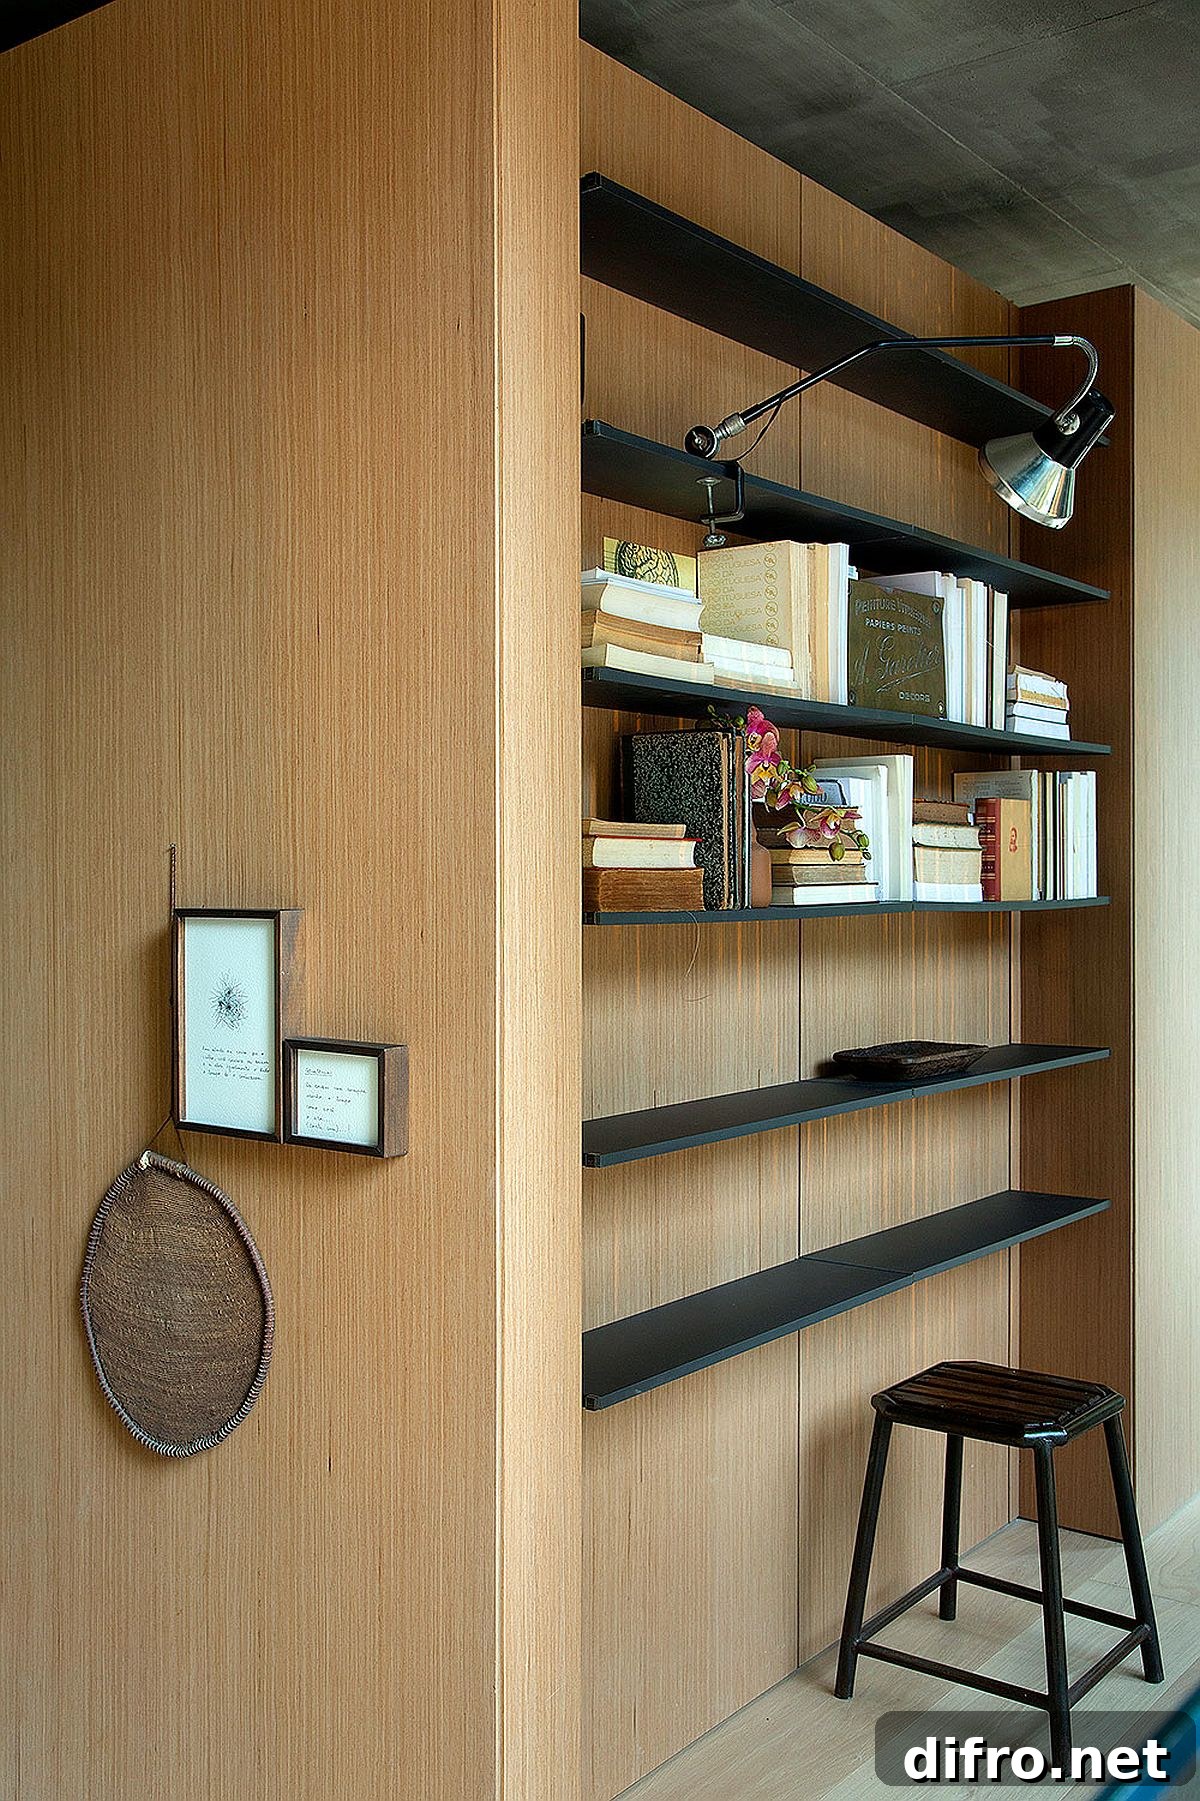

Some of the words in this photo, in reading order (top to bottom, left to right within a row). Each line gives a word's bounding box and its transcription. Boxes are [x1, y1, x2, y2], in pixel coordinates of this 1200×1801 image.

[855, 598, 897, 616] PEINTURE
[865, 617, 896, 632] PAPIERS
[897, 623, 922, 636] PEINTS
